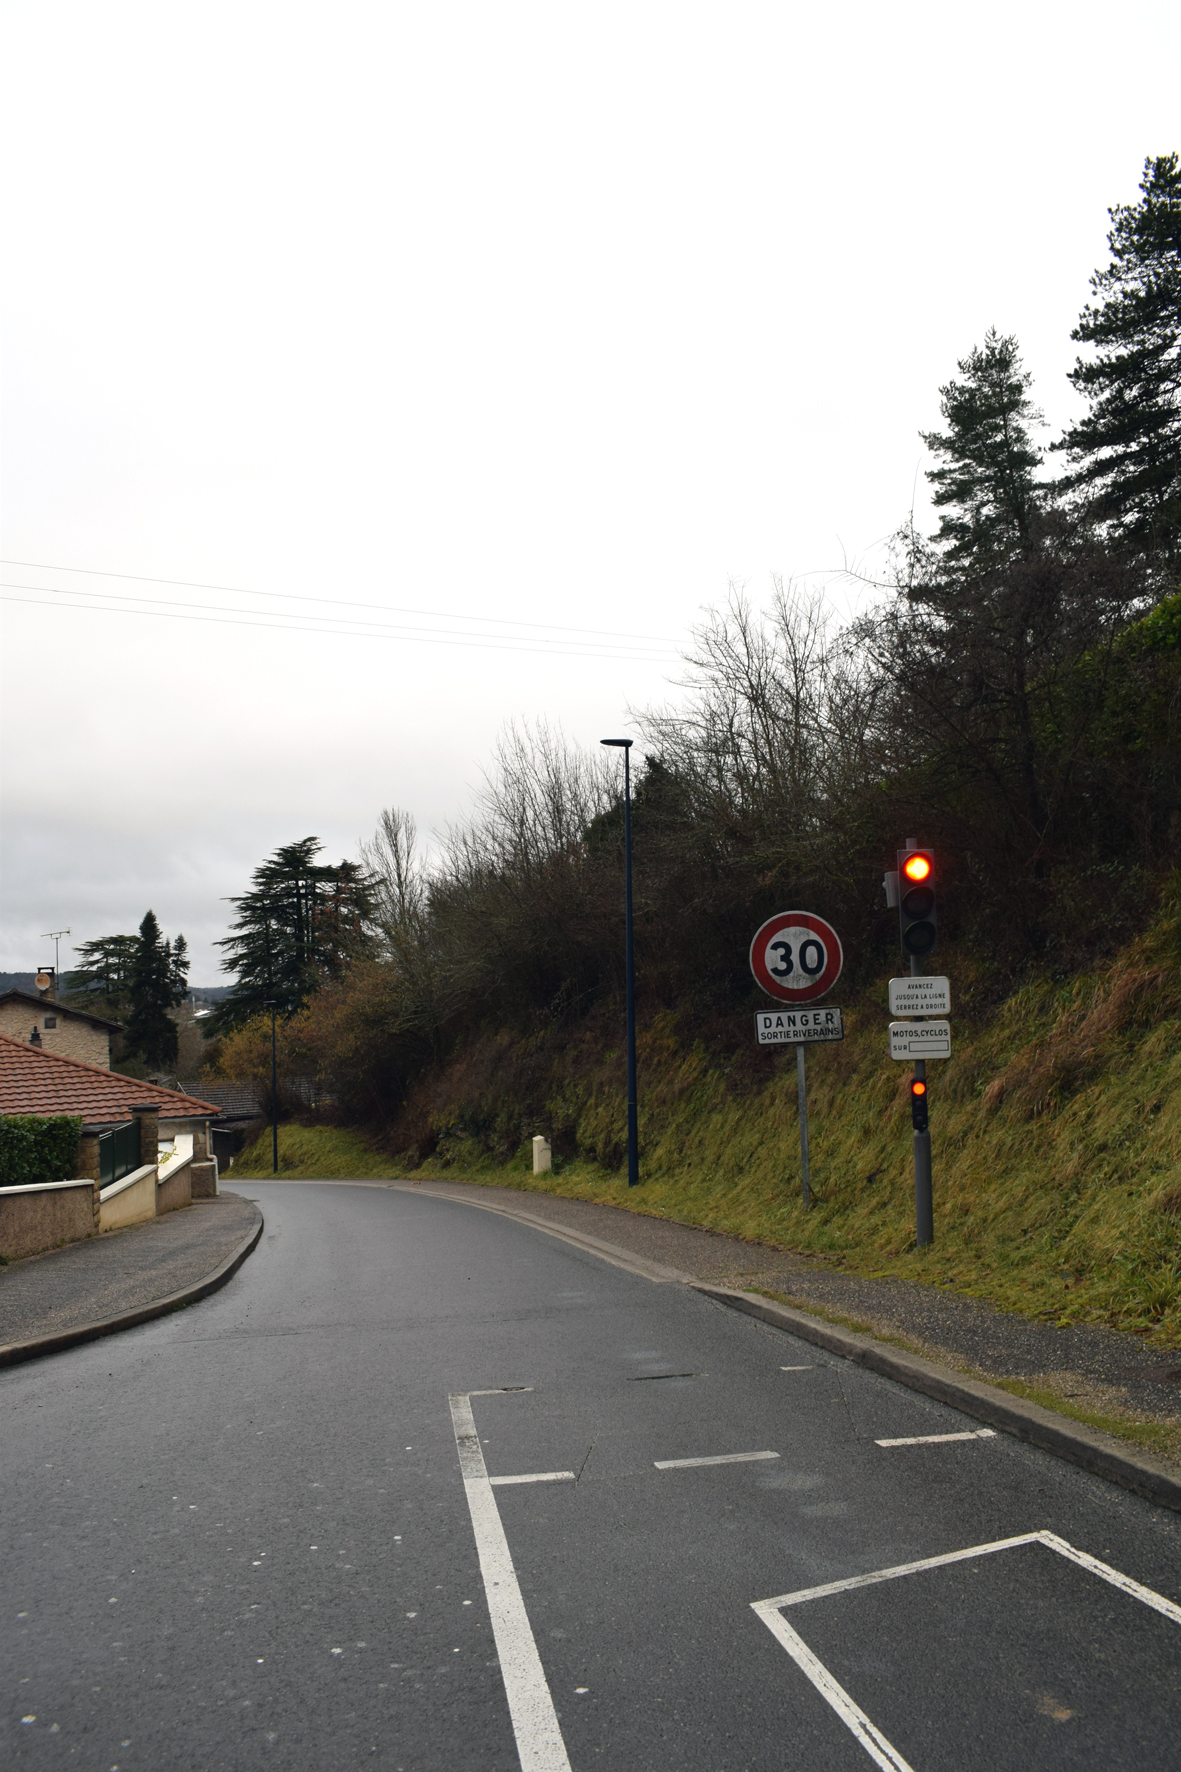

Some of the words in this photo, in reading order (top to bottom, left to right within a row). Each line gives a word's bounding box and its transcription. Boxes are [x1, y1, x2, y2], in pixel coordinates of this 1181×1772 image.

[770, 939, 825, 977] 30
[763, 1012, 835, 1029] DANGER
[760, 1030, 791, 1041] SORTIE
[793, 1027, 840, 1038] RIVERAINS
